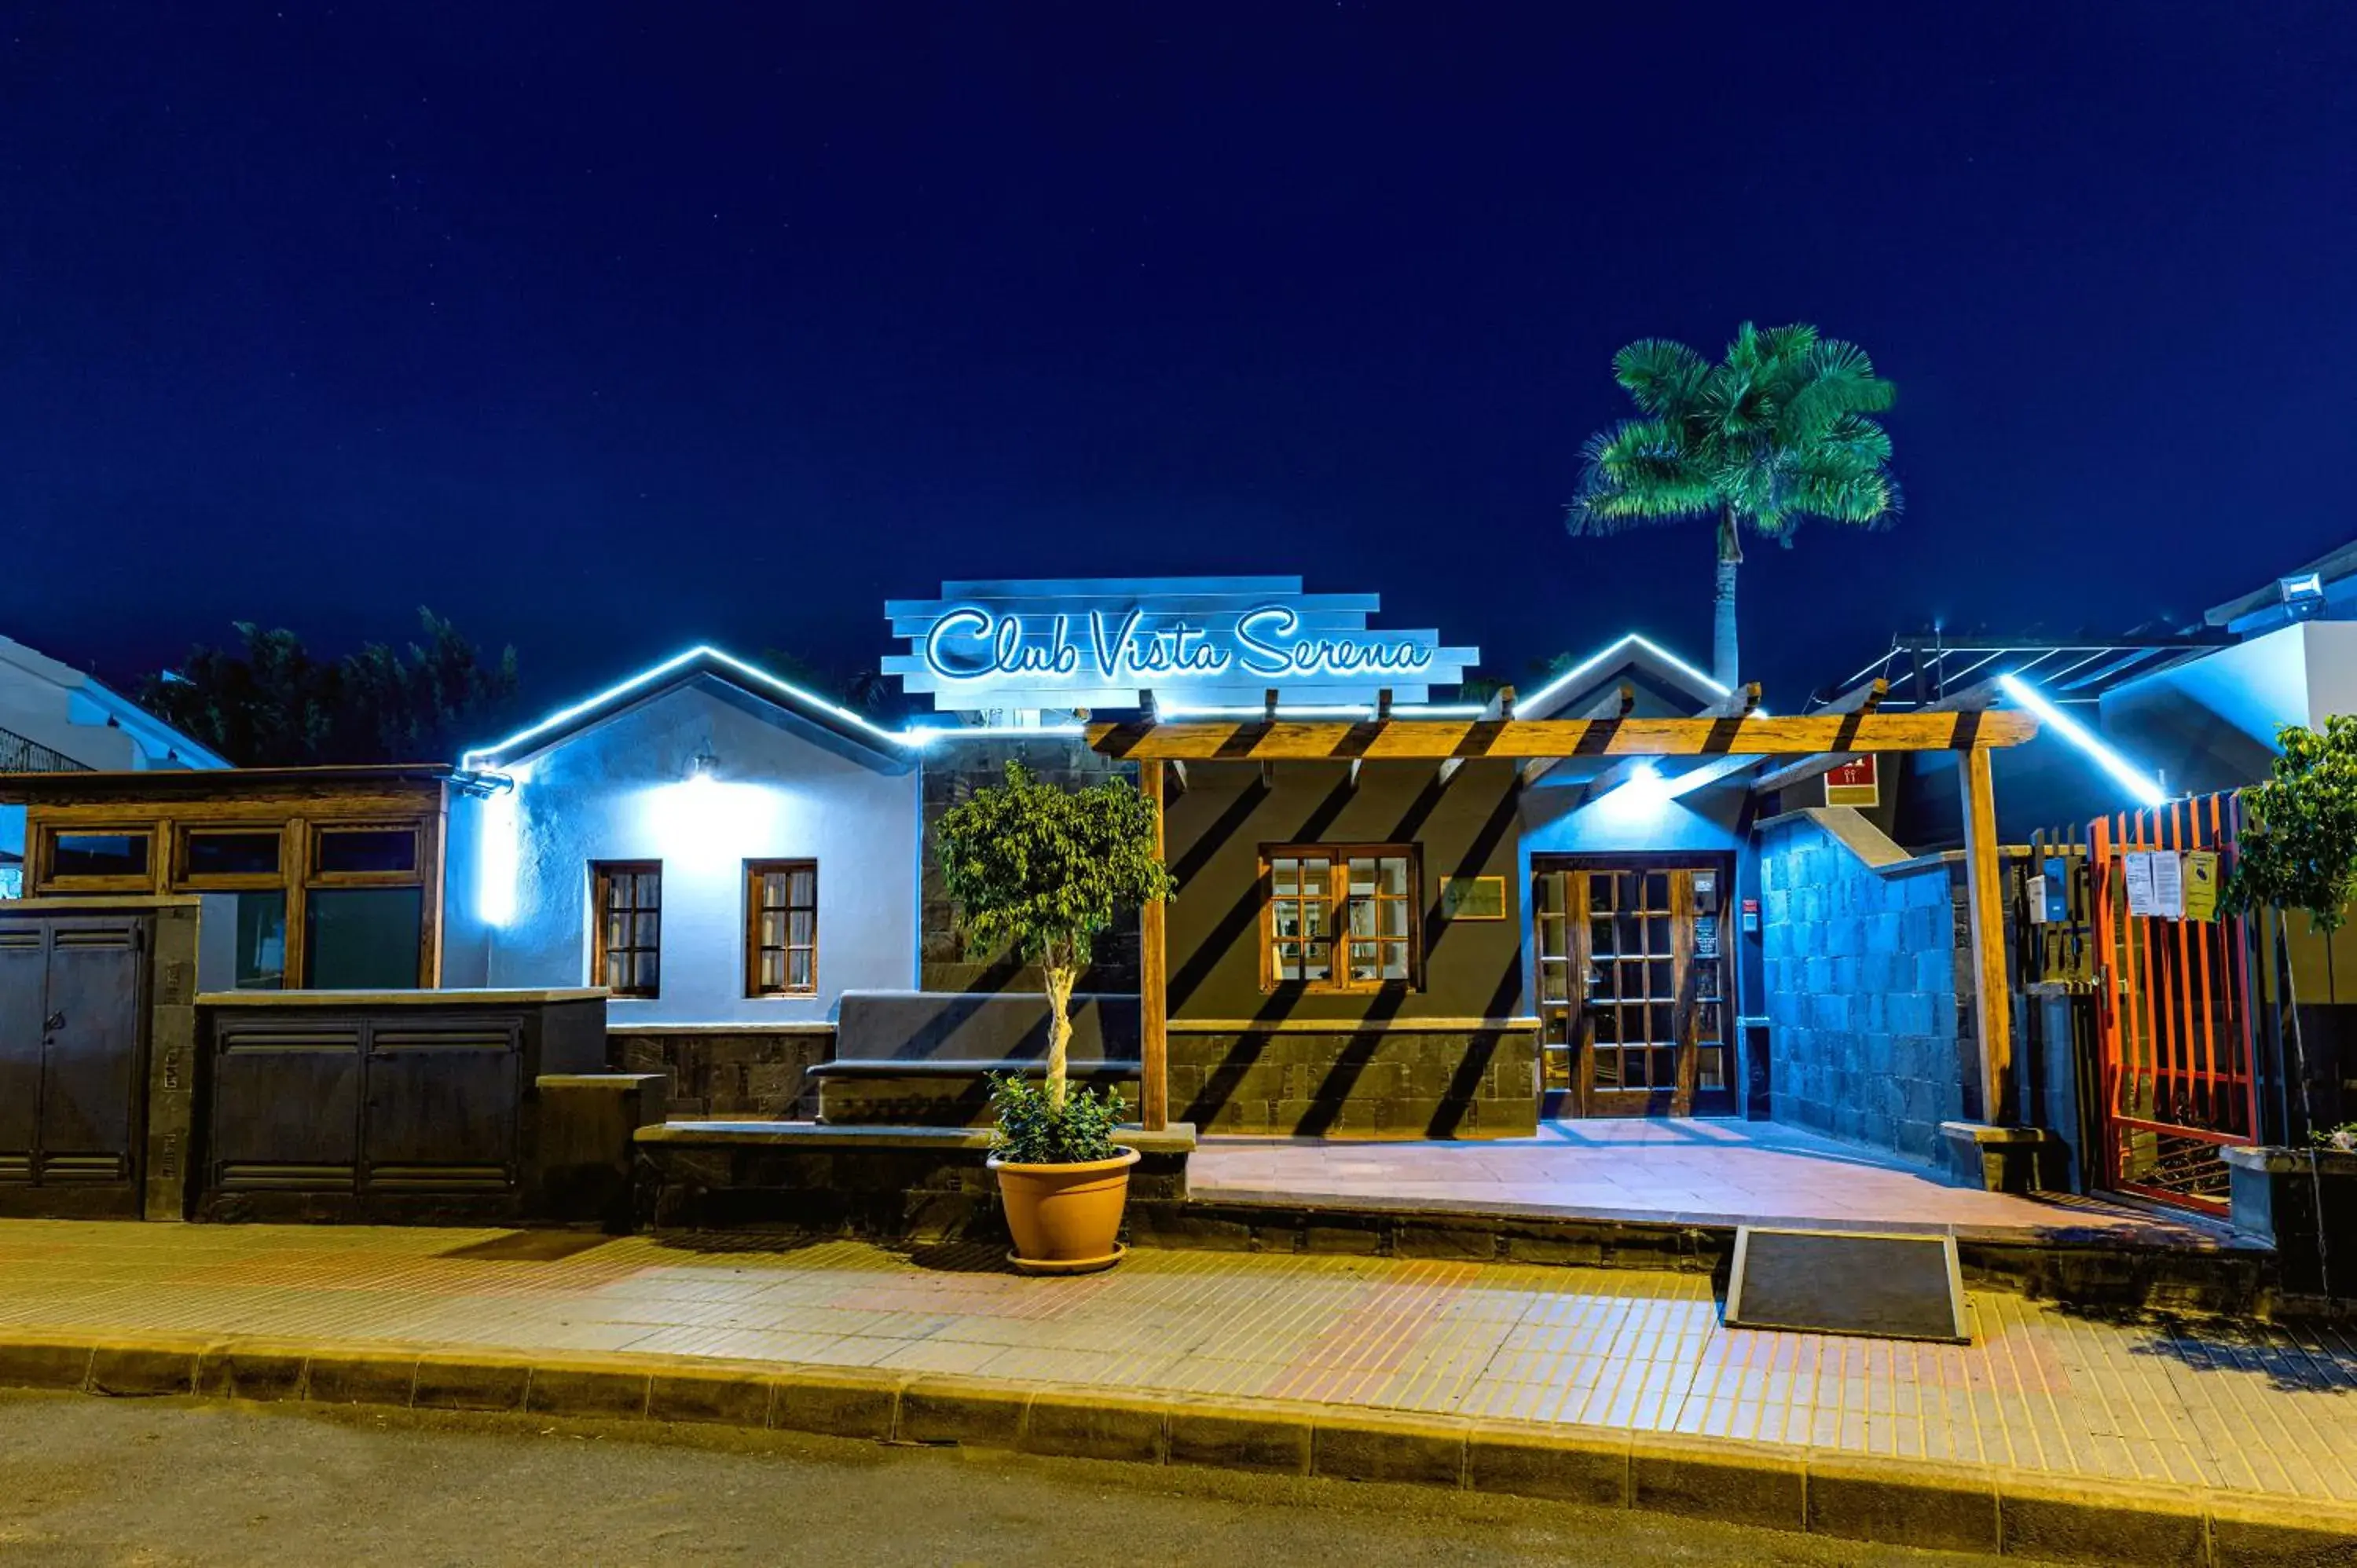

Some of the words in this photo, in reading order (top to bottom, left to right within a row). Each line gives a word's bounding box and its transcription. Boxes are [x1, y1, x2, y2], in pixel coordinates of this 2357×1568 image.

[926, 609, 1077, 679] Club
[1091, 610, 1230, 676] Vista
[1237, 606, 1431, 672] Serena
